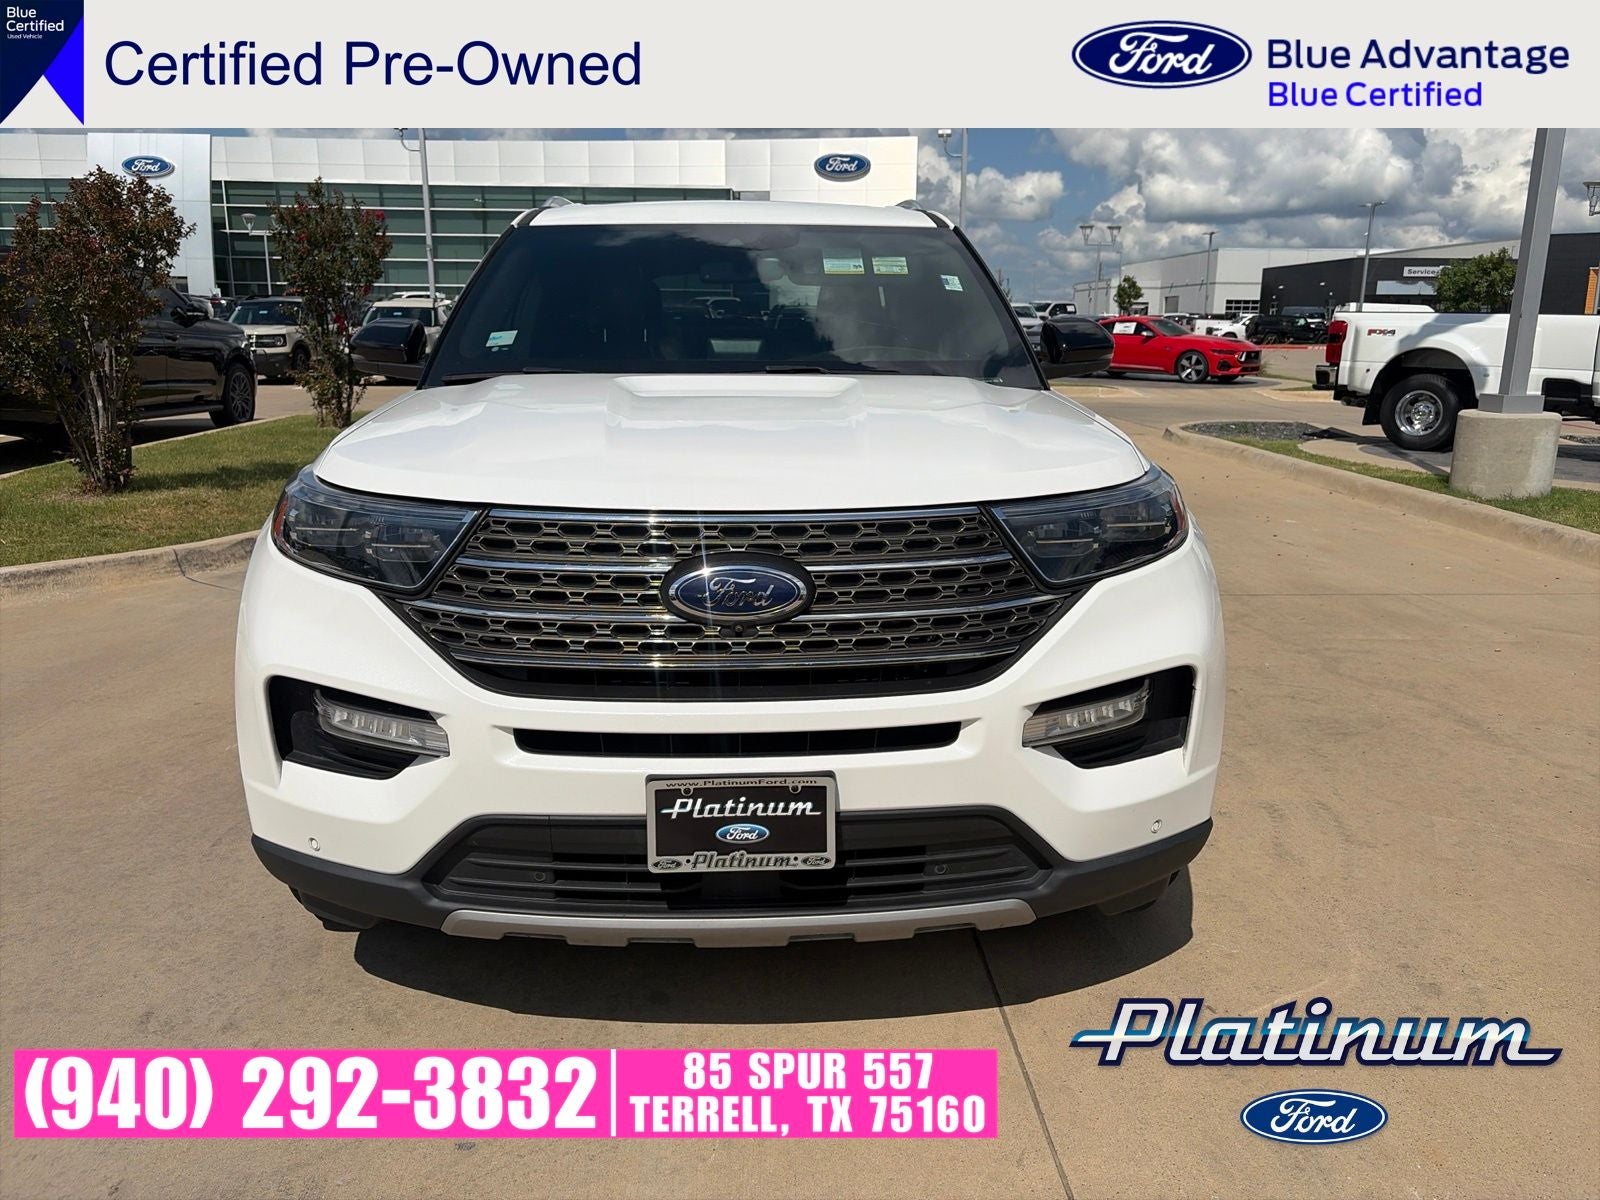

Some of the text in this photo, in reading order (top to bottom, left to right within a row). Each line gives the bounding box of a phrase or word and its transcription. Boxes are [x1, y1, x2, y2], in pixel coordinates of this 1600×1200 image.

[131, 159, 161, 171] Ford
[825, 156, 859, 171] Ford
[1367, 328, 1396, 336] FX4
[697, 576, 775, 608] Ford
[666, 778, 818, 788] www.PlatinumFord.com
[660, 796, 822, 820] Platinum
[726, 826, 759, 840] Ford
[657, 859, 677, 869] Ford
[691, 852, 798, 870] Platinum
[806, 856, 827, 866] Ford
